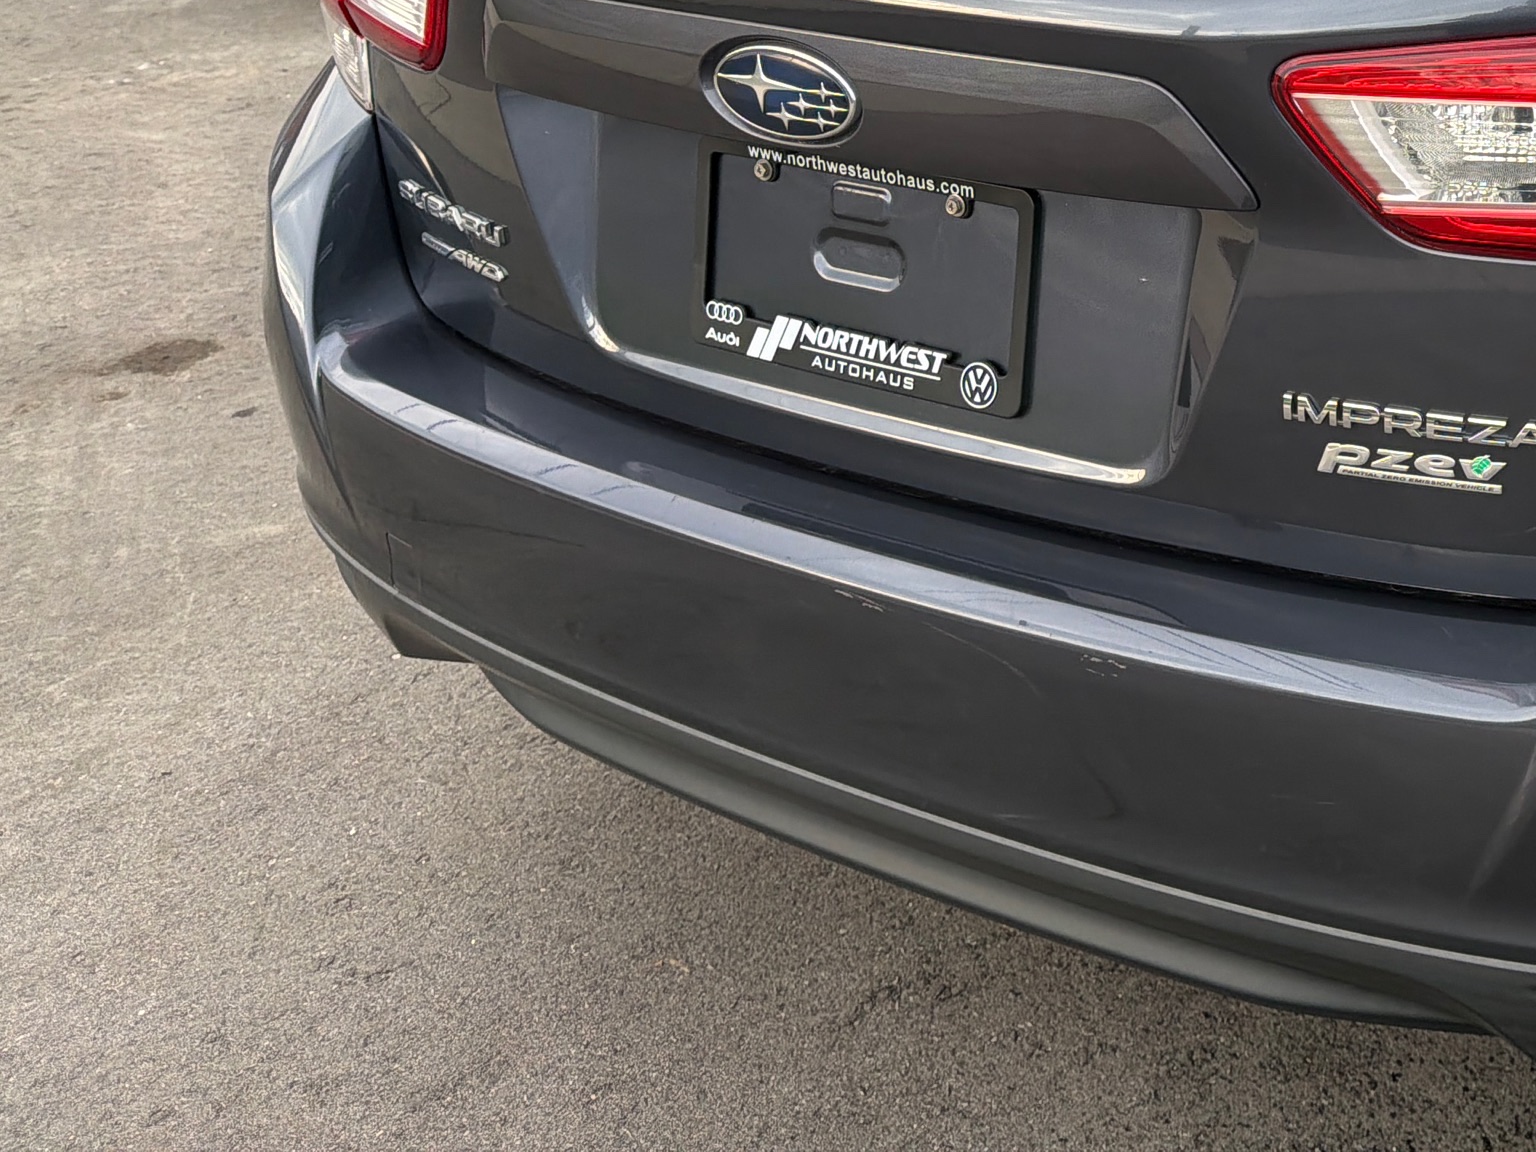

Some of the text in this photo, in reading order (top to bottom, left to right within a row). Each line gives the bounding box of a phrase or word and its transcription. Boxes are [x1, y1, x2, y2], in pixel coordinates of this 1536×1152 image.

[748, 146, 974, 198] www.northwestautohaus.com
[398, 179, 504, 248] SUBARU
[705, 327, 740, 346] Audi
[800, 322, 947, 374] NORTHWEST
[811, 356, 915, 390] AUTOHAUS
[1342, 469, 1495, 493] PARTIAL ZERO EMISSION VEHICLE
